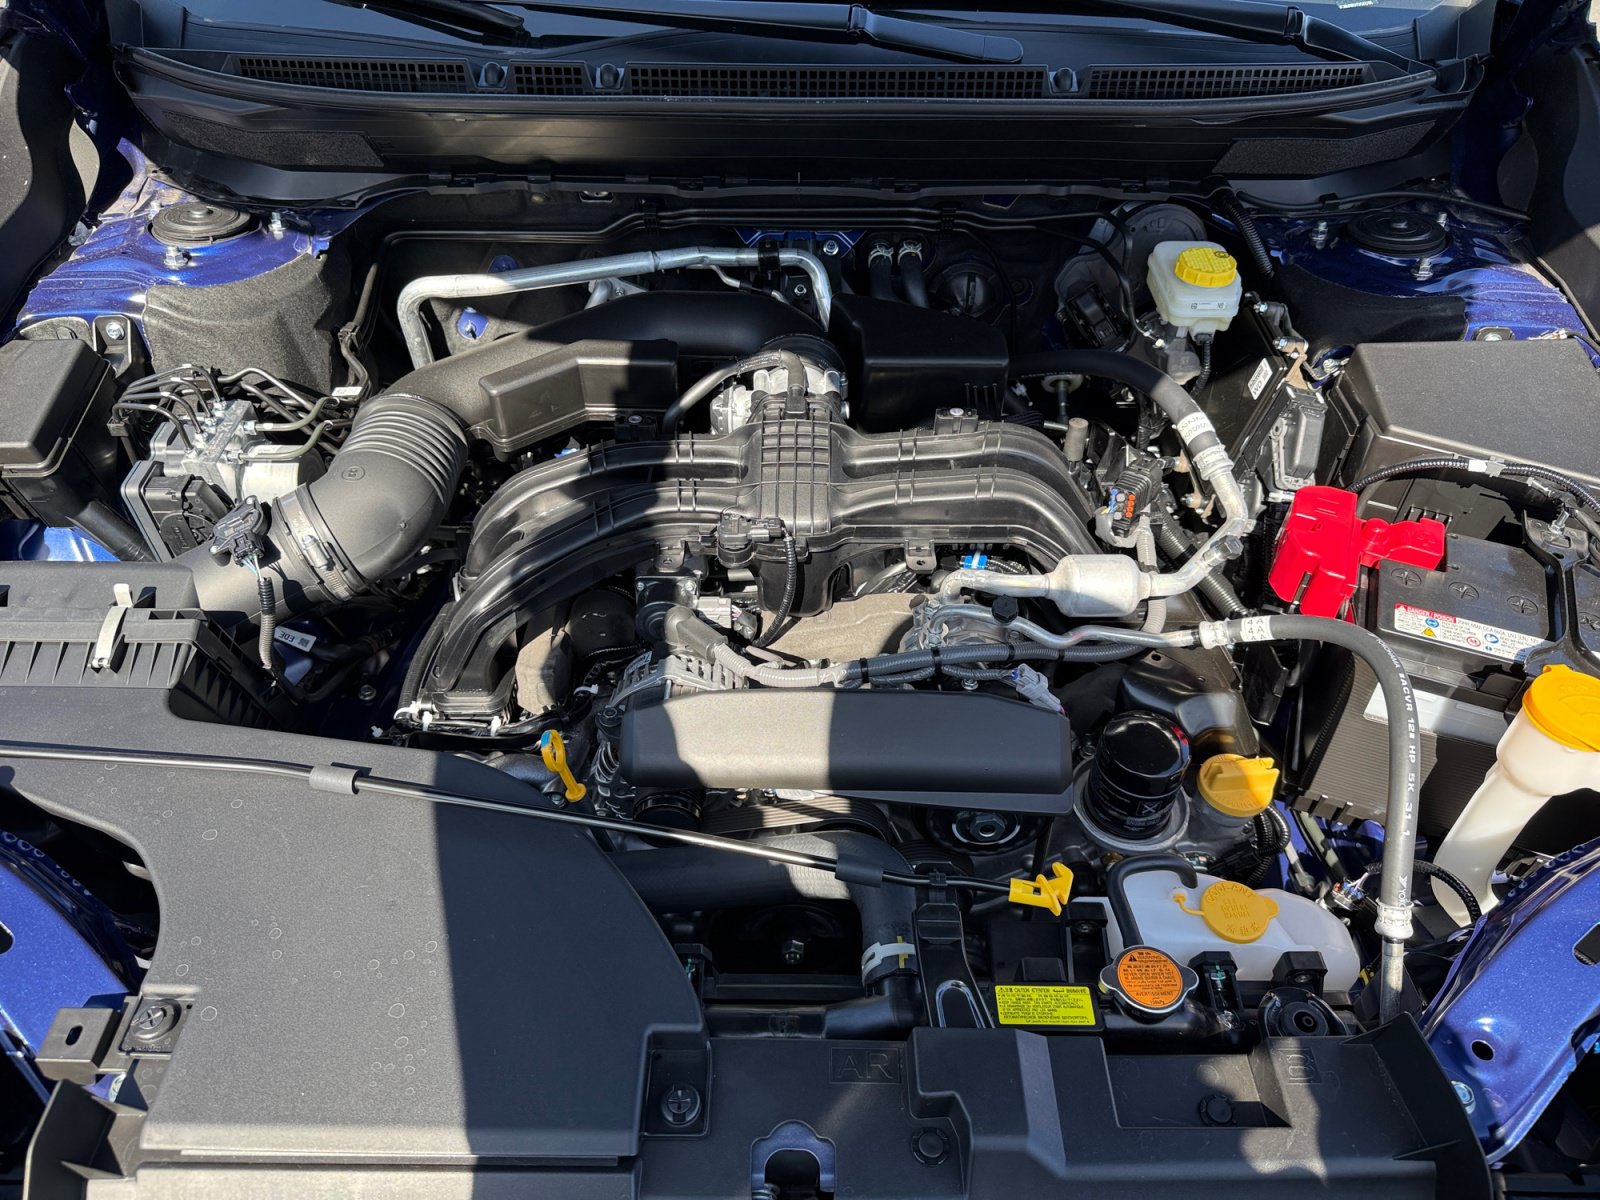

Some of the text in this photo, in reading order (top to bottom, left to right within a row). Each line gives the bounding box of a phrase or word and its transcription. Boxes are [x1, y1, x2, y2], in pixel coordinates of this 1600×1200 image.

[278, 631, 296, 643] EDE
[1408, 745, 1416, 764] HP
[835, 1053, 894, 1079] AR
